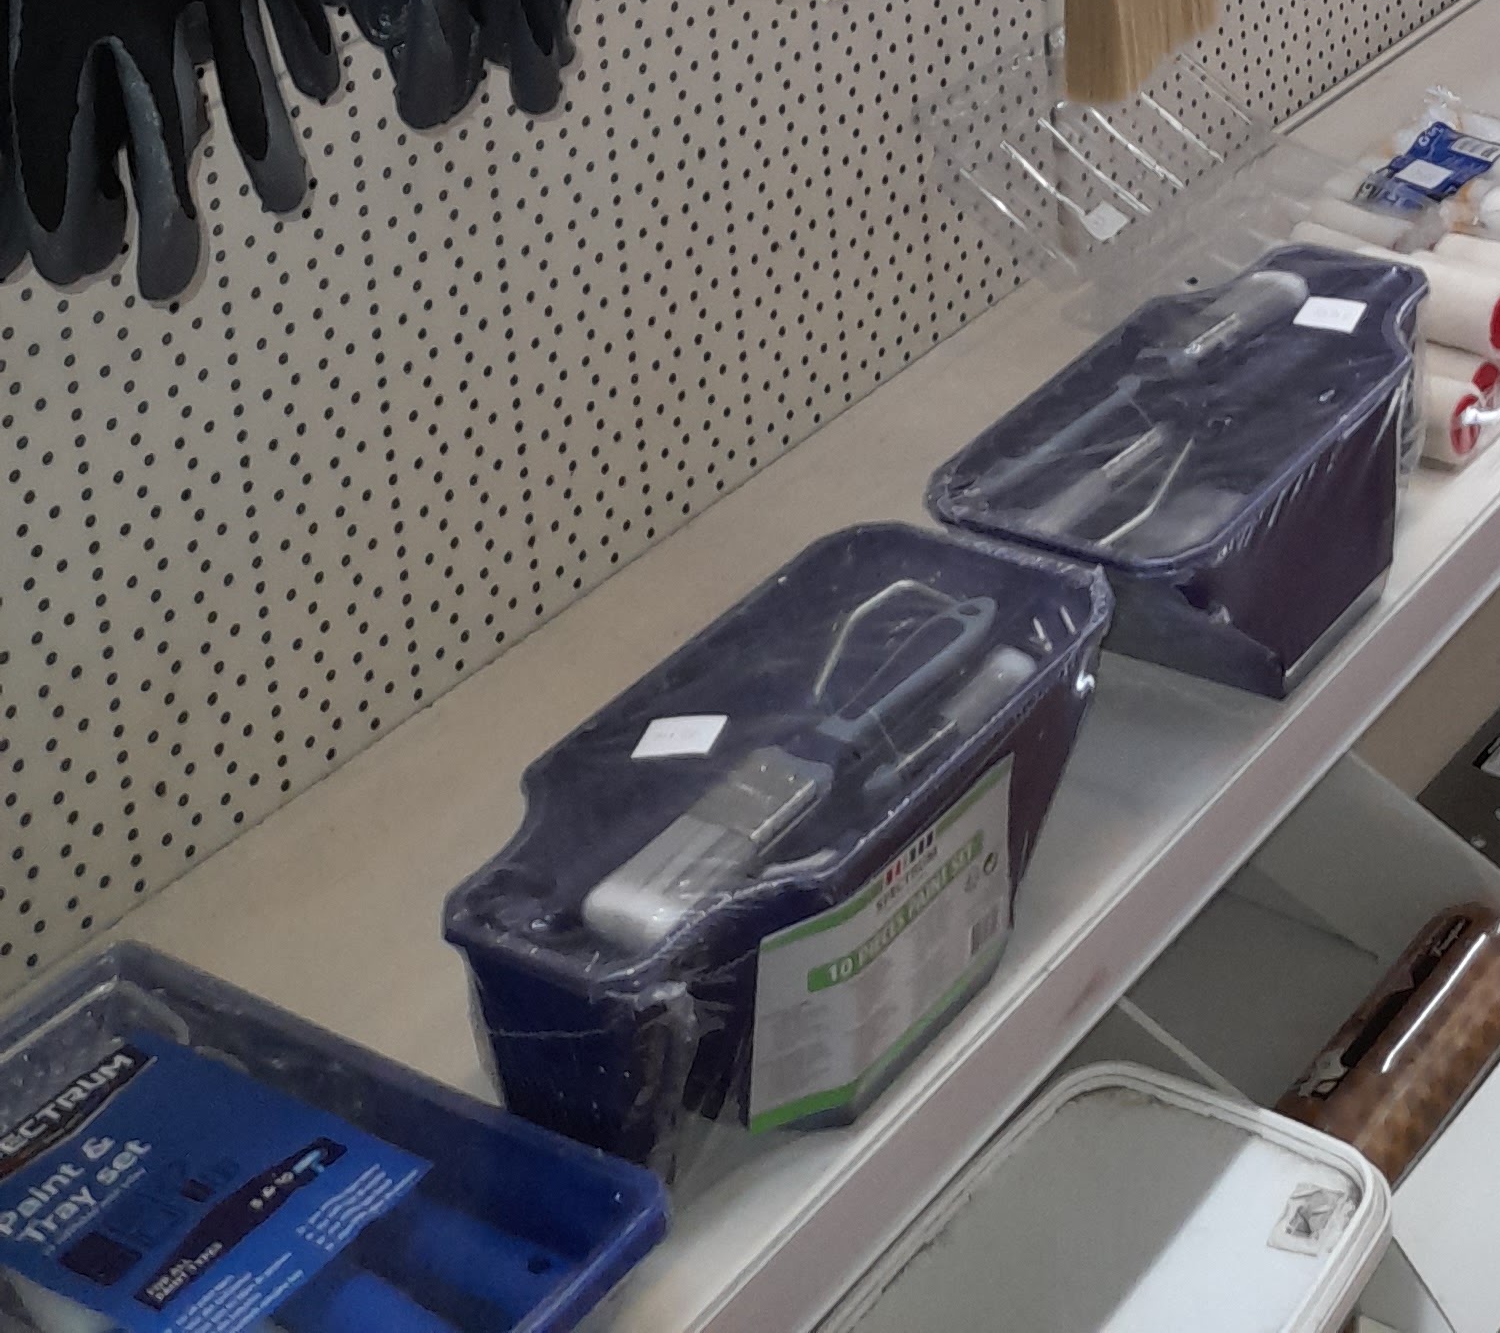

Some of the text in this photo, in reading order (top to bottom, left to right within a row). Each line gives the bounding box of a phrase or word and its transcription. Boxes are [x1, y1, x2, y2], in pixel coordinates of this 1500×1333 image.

[827, 956, 855, 983] 10
[0, 1053, 135, 1155] ECTRUM
[0, 1135, 116, 1236] Paint &
[15, 1139, 152, 1243] Tray set
